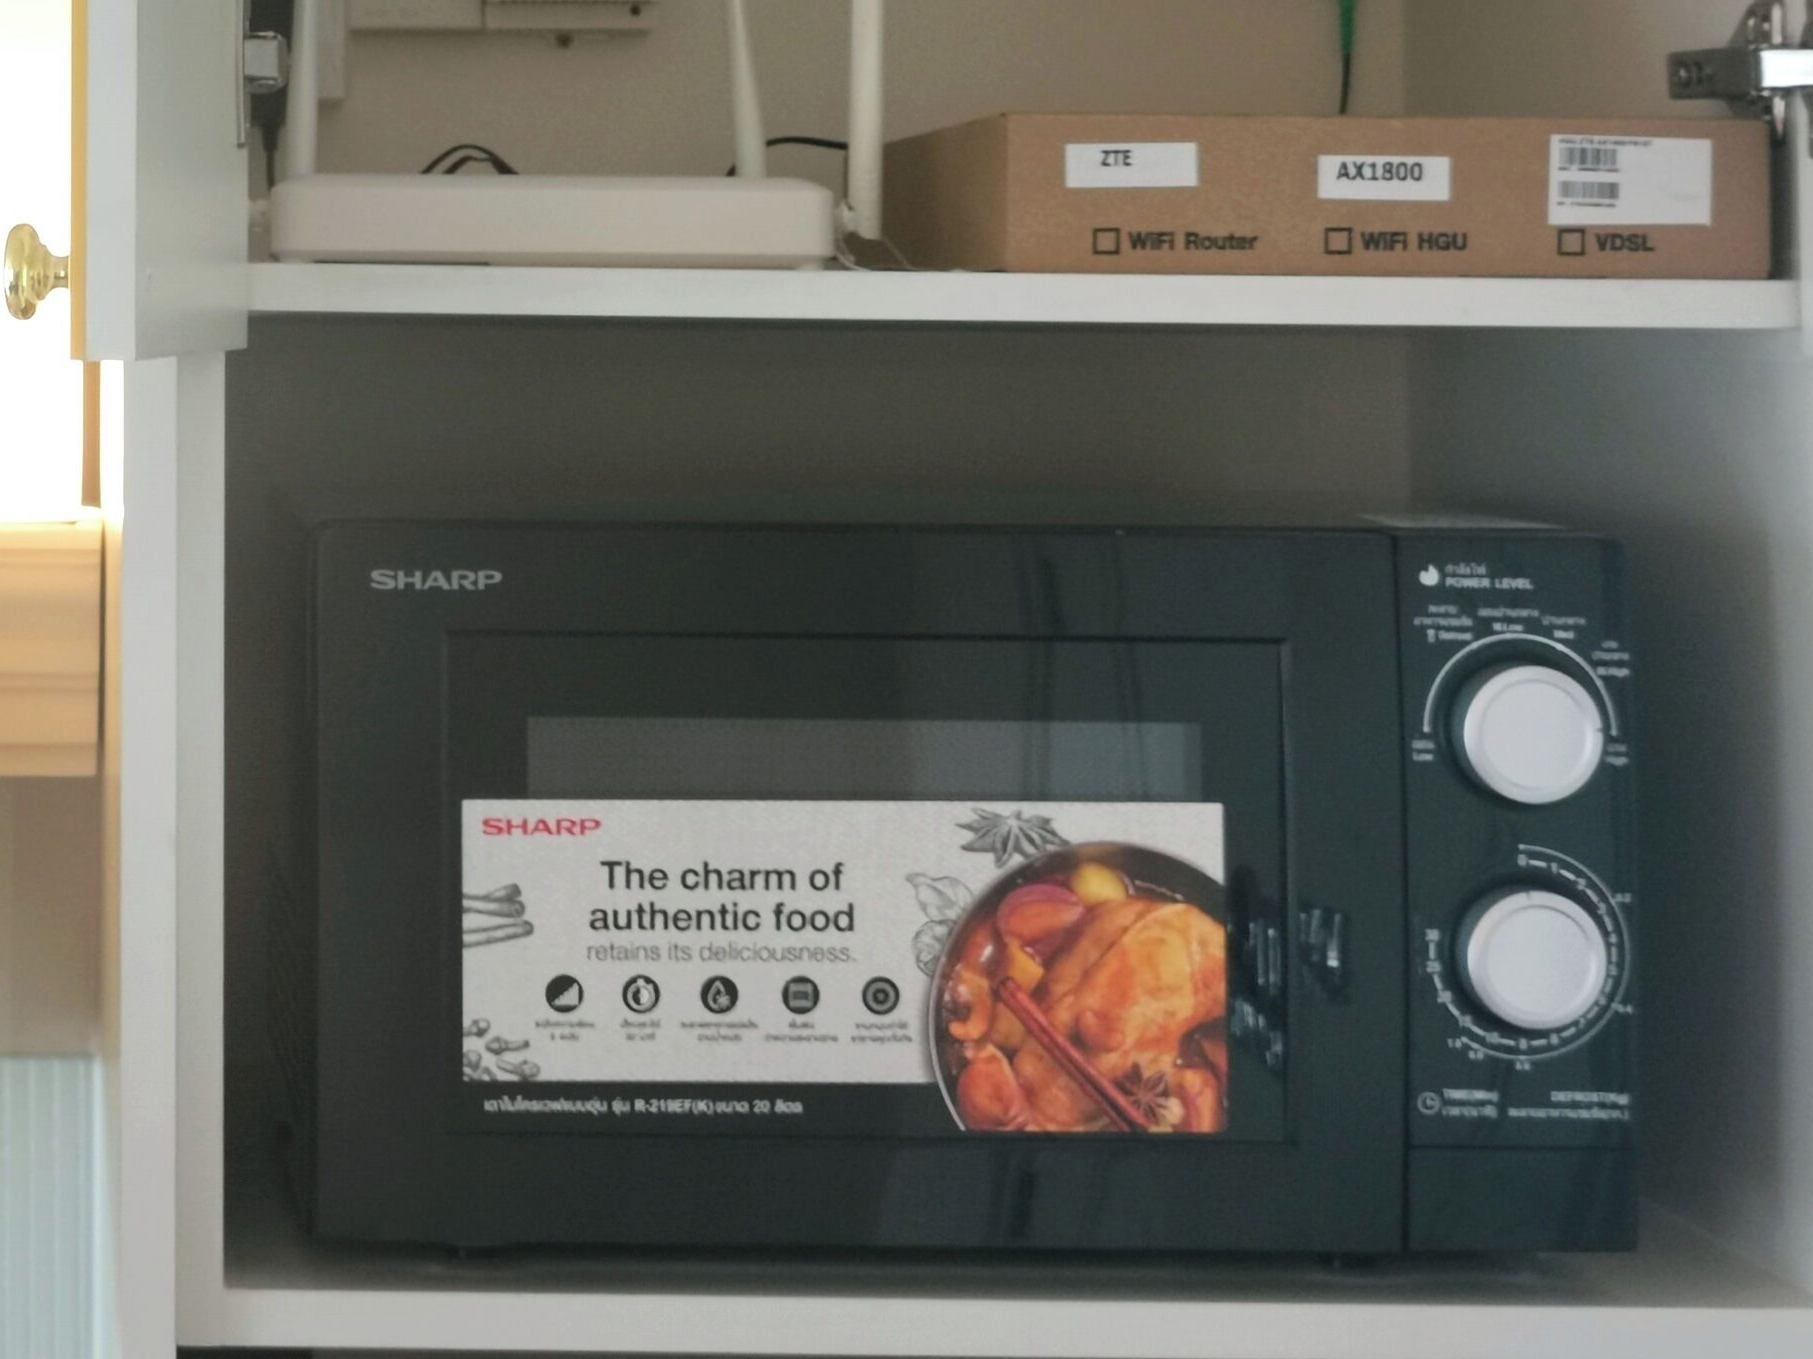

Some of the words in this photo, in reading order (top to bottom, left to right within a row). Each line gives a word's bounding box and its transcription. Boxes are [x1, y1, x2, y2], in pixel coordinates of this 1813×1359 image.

[1101, 150, 1133, 167] ZTE
[1335, 160, 1423, 183] AX1800
[1184, 232, 1259, 251] Router
[1417, 233, 1468, 252] HGU
[1594, 234, 1655, 253] VDSL
[370, 569, 503, 592] SHARP
[1445, 578, 1490, 588] POWER
[1495, 578, 1533, 589] LEVEL
[481, 816, 602, 837] SHARP
[601, 860, 668, 892] The
[678, 860, 797, 892] charm
[809, 860, 845, 892] of
[589, 900, 763, 933] authentic
[773, 900, 857, 933] food
[585, 941, 662, 964] retains
[668, 941, 692, 964] its
[697, 941, 858, 964] deliciousness.
[752, 1099, 771, 1114] 20
